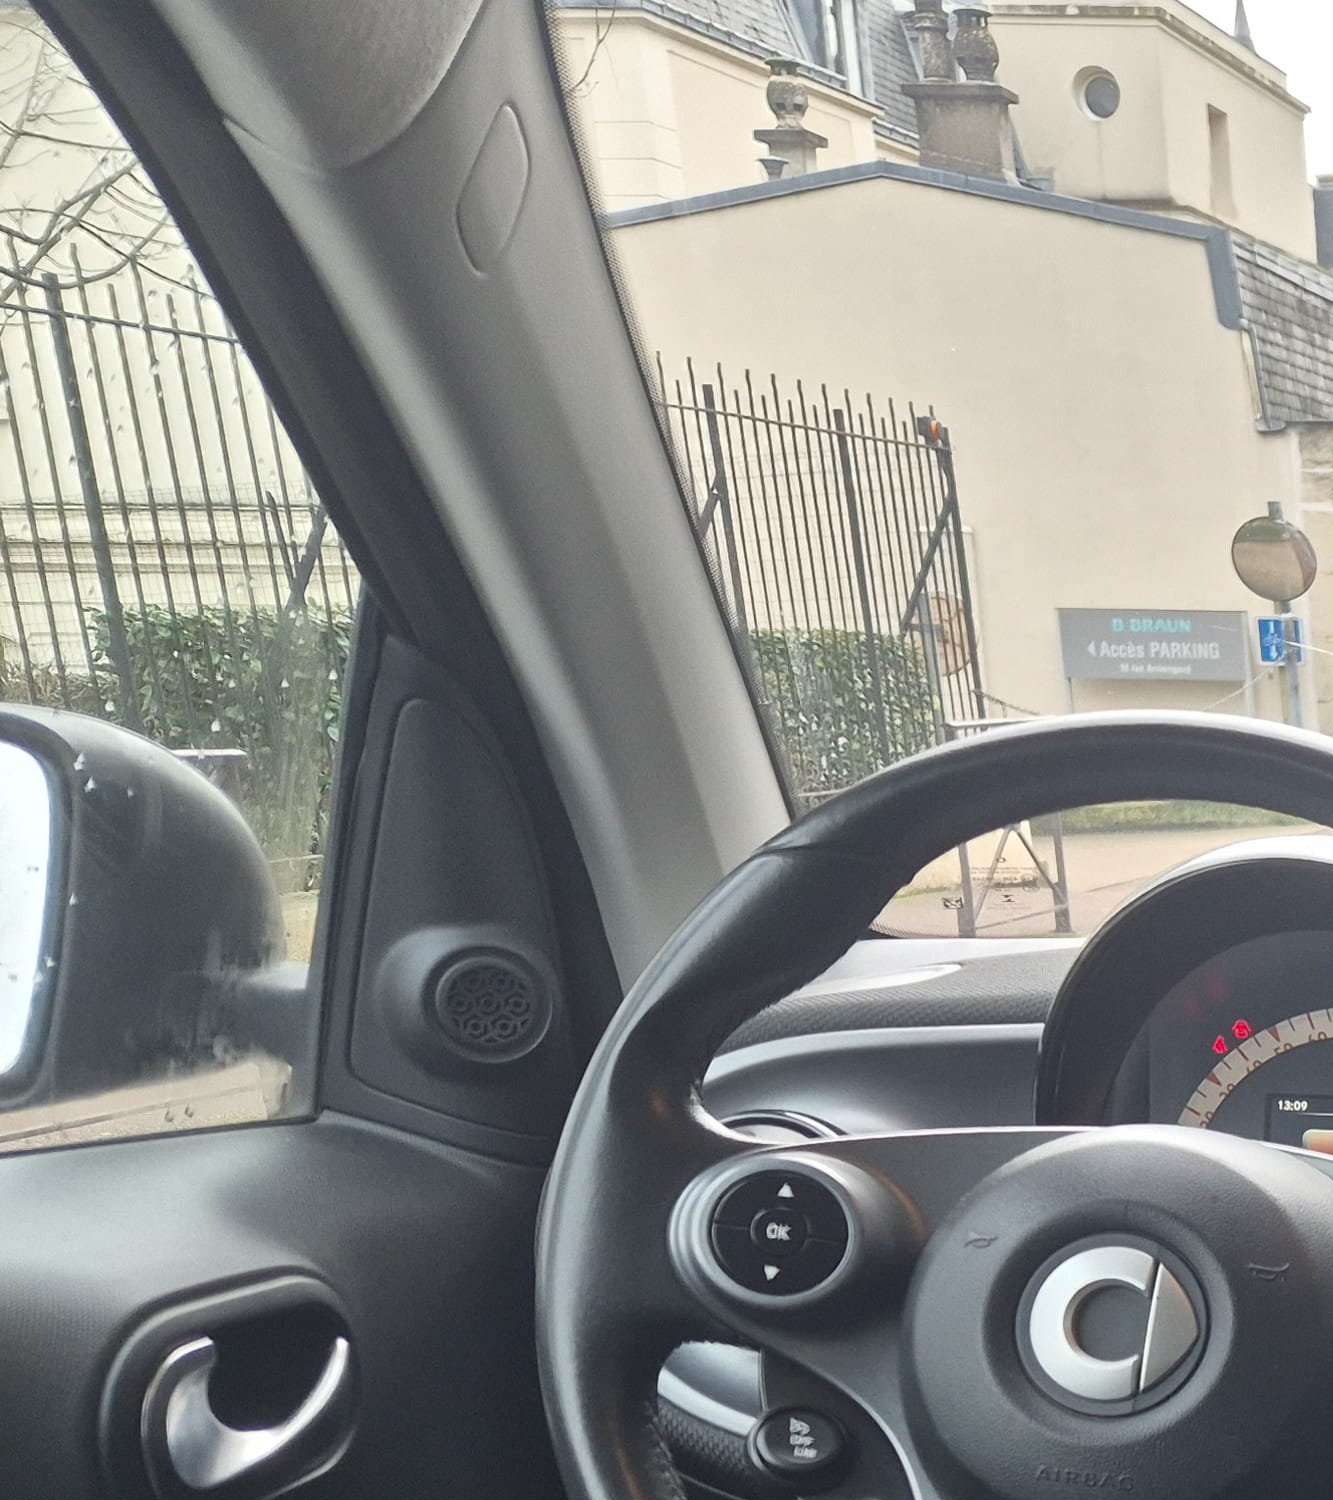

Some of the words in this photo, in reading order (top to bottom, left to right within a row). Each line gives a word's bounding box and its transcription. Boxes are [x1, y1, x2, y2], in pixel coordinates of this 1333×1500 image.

[1130, 618, 1191, 633] BRAUN
[1100, 640, 1145, 658] Accès
[1150, 641, 1220, 659] PARKING
[1278, 1100, 1308, 1111] 13:09
[766, 1221, 791, 1241] OK
[1035, 1464, 1137, 1492] AIRBAG
